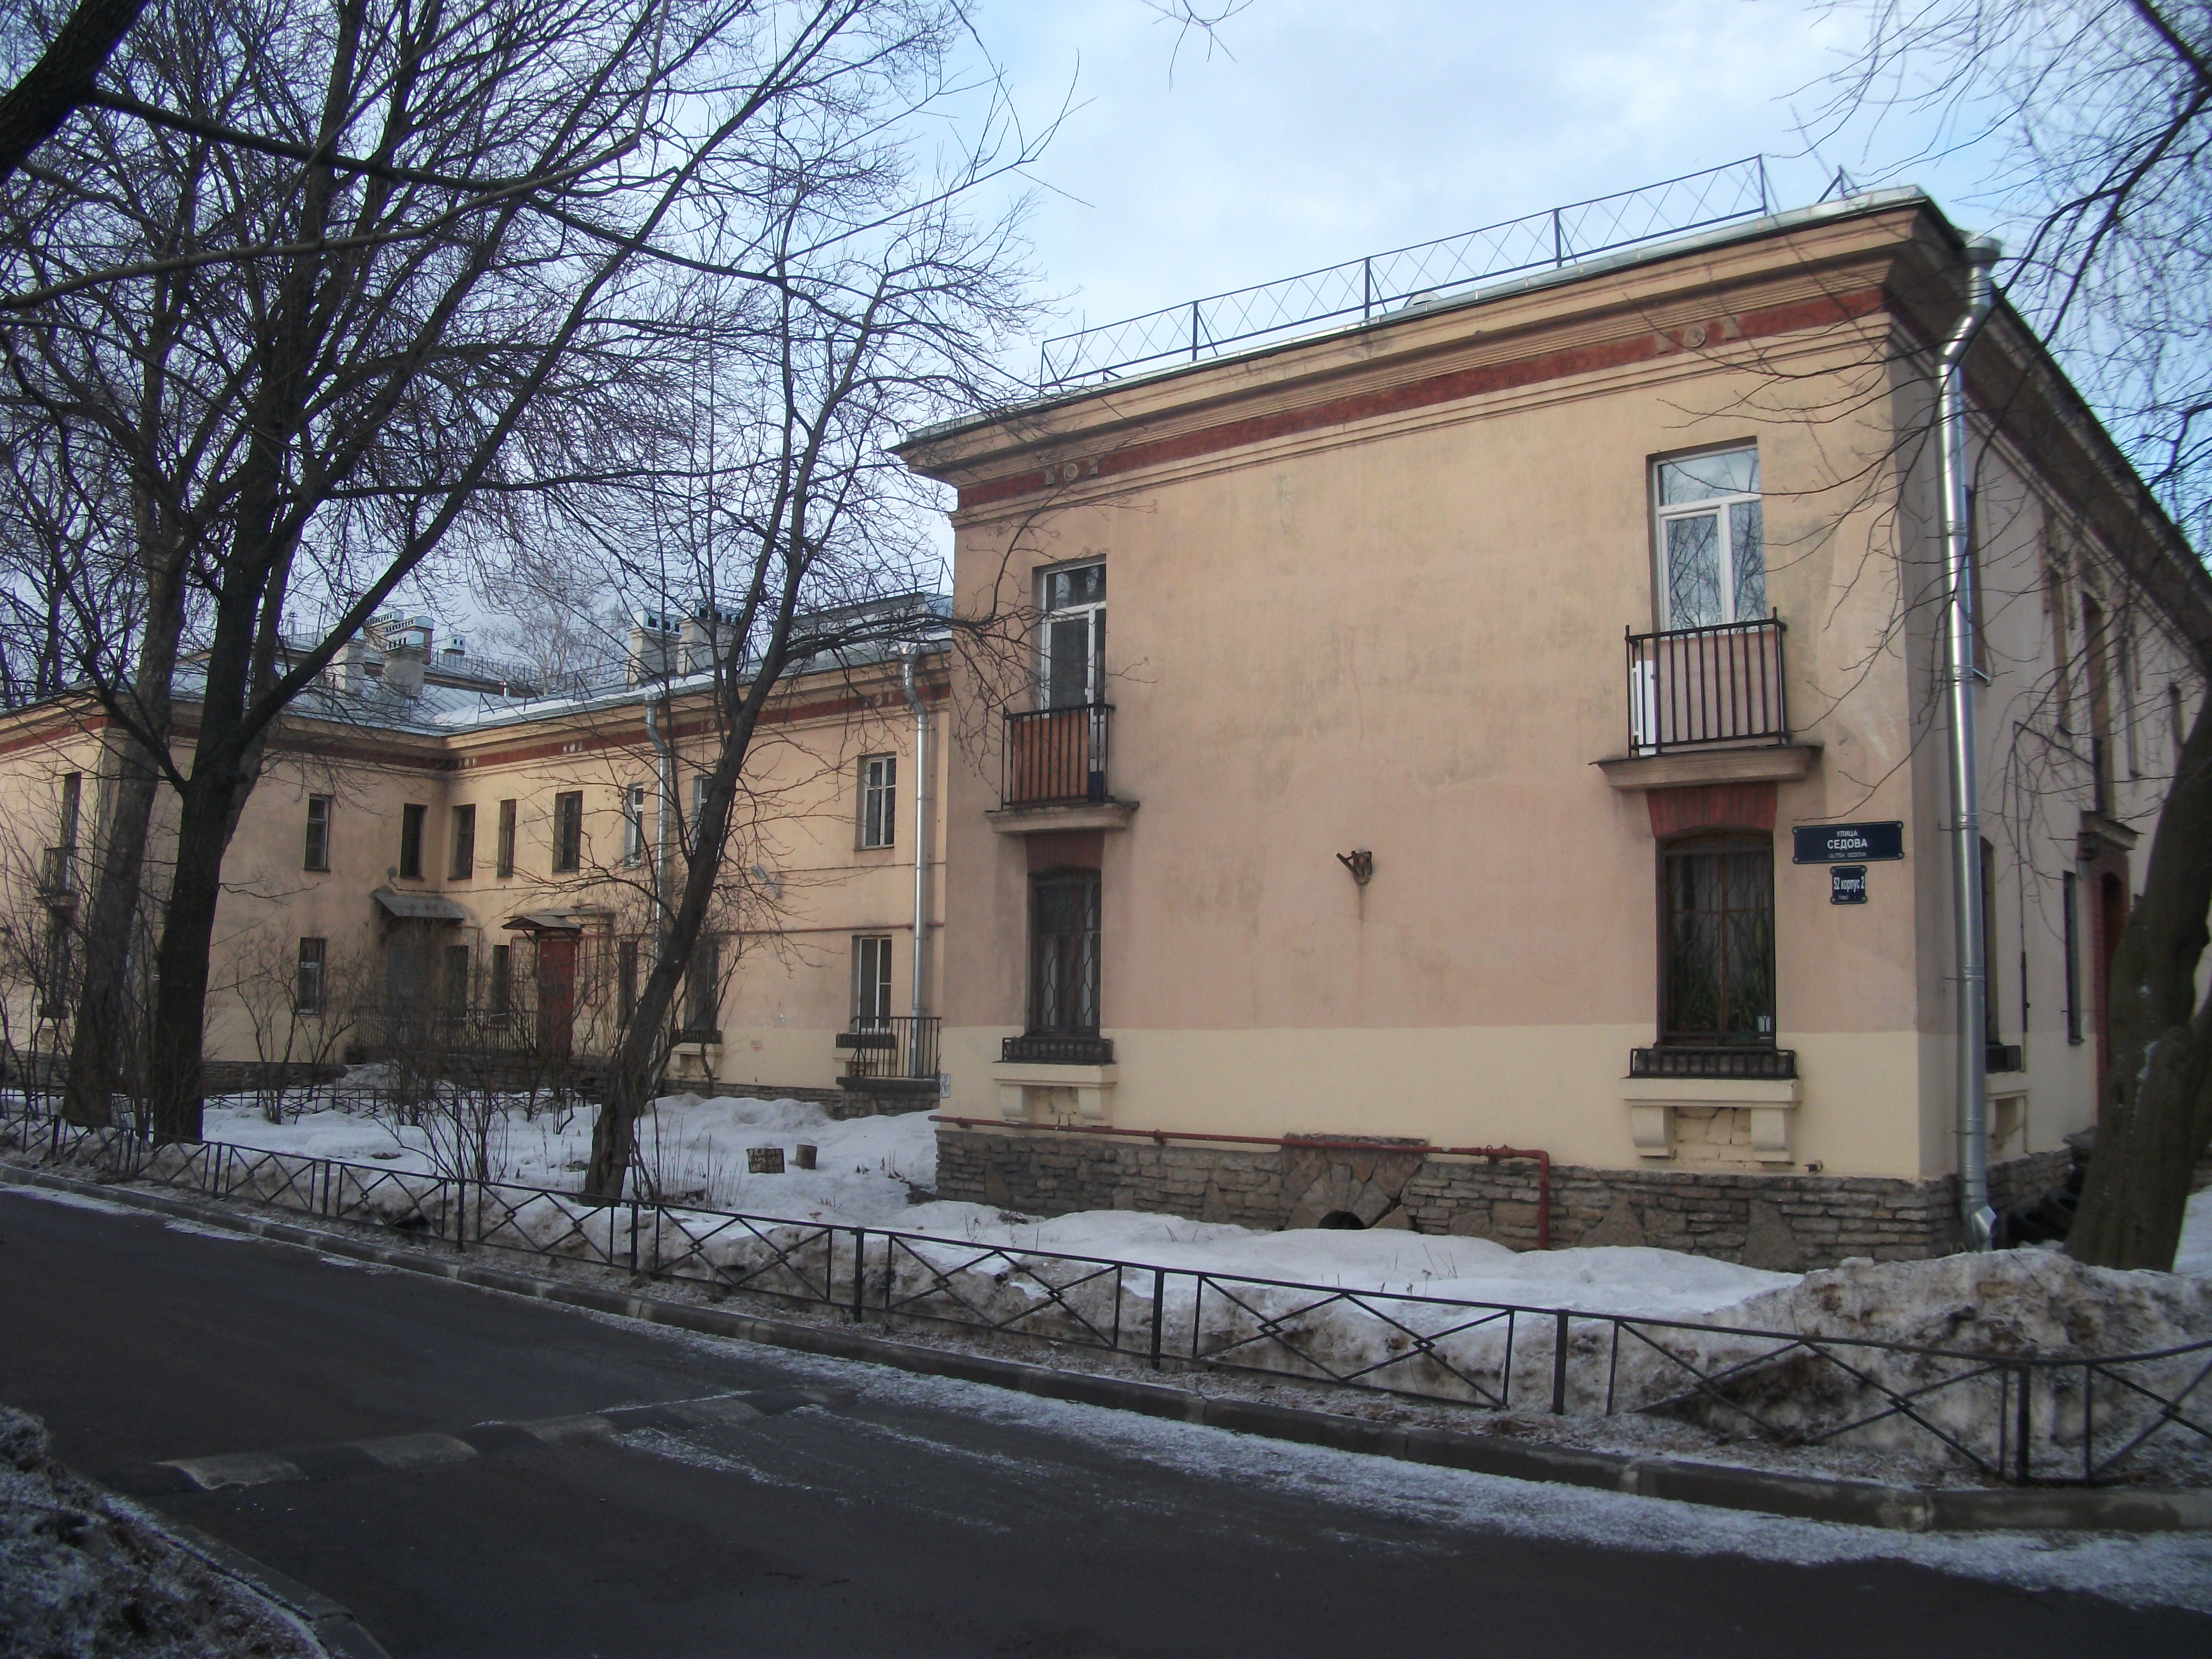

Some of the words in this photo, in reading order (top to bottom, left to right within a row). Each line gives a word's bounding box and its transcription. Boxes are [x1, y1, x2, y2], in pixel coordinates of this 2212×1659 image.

[1827, 838, 1868, 850] СЕДОВА
[1841, 879, 1860, 893] корпус
[1861, 875, 1865, 889] 2
